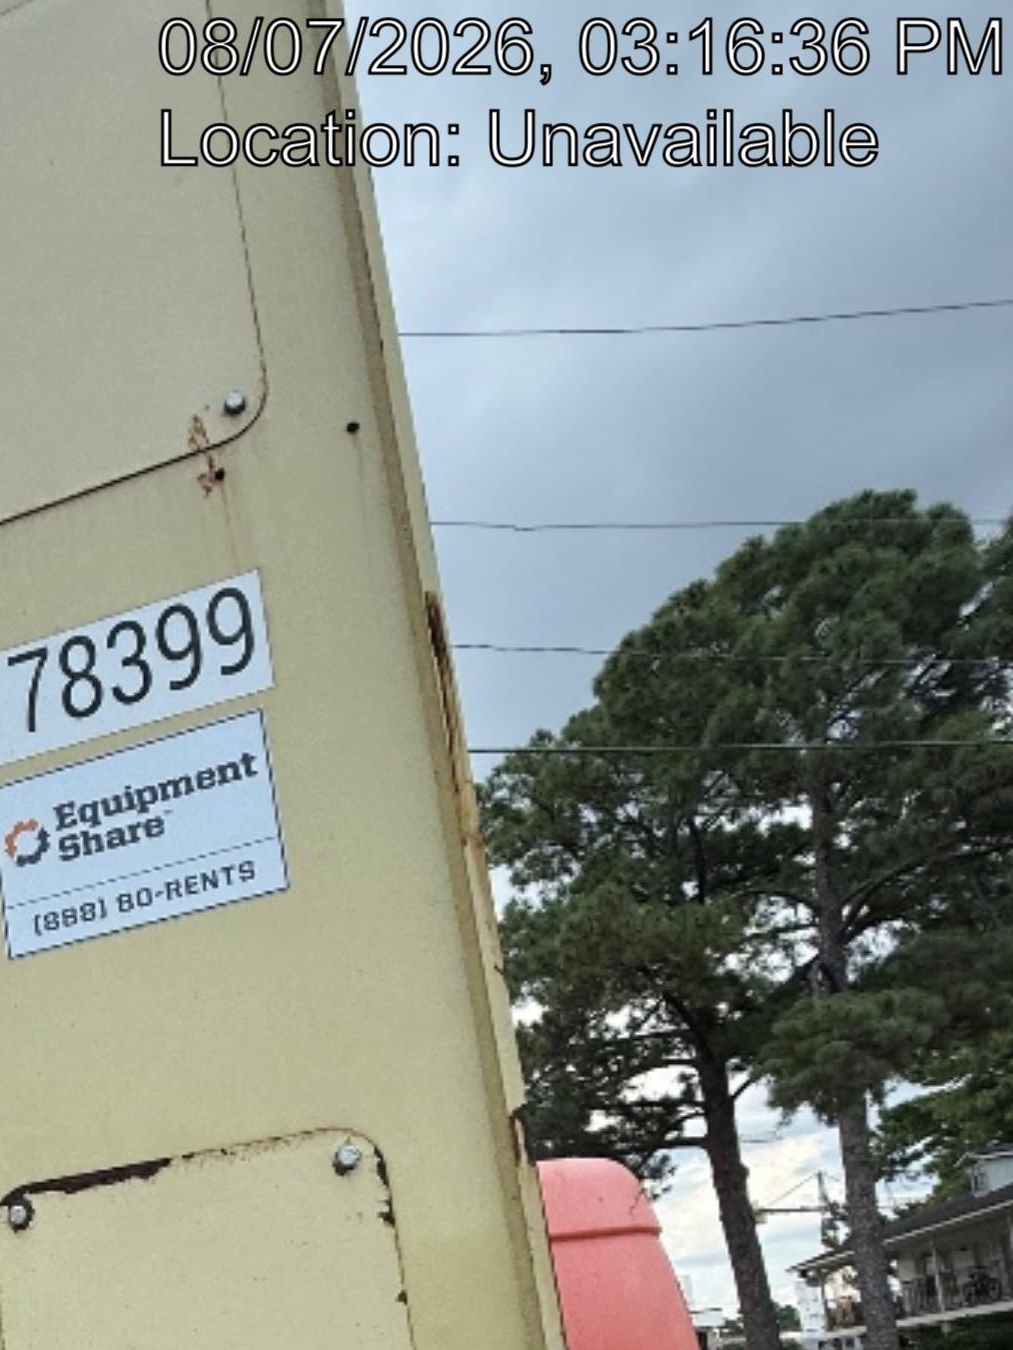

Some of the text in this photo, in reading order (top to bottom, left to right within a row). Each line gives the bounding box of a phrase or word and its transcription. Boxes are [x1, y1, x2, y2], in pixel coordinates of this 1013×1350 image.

[53, 751, 258, 833] Equipment
[58, 814, 166, 863] Share
[116, 860, 256, 914] 80-RENTS
